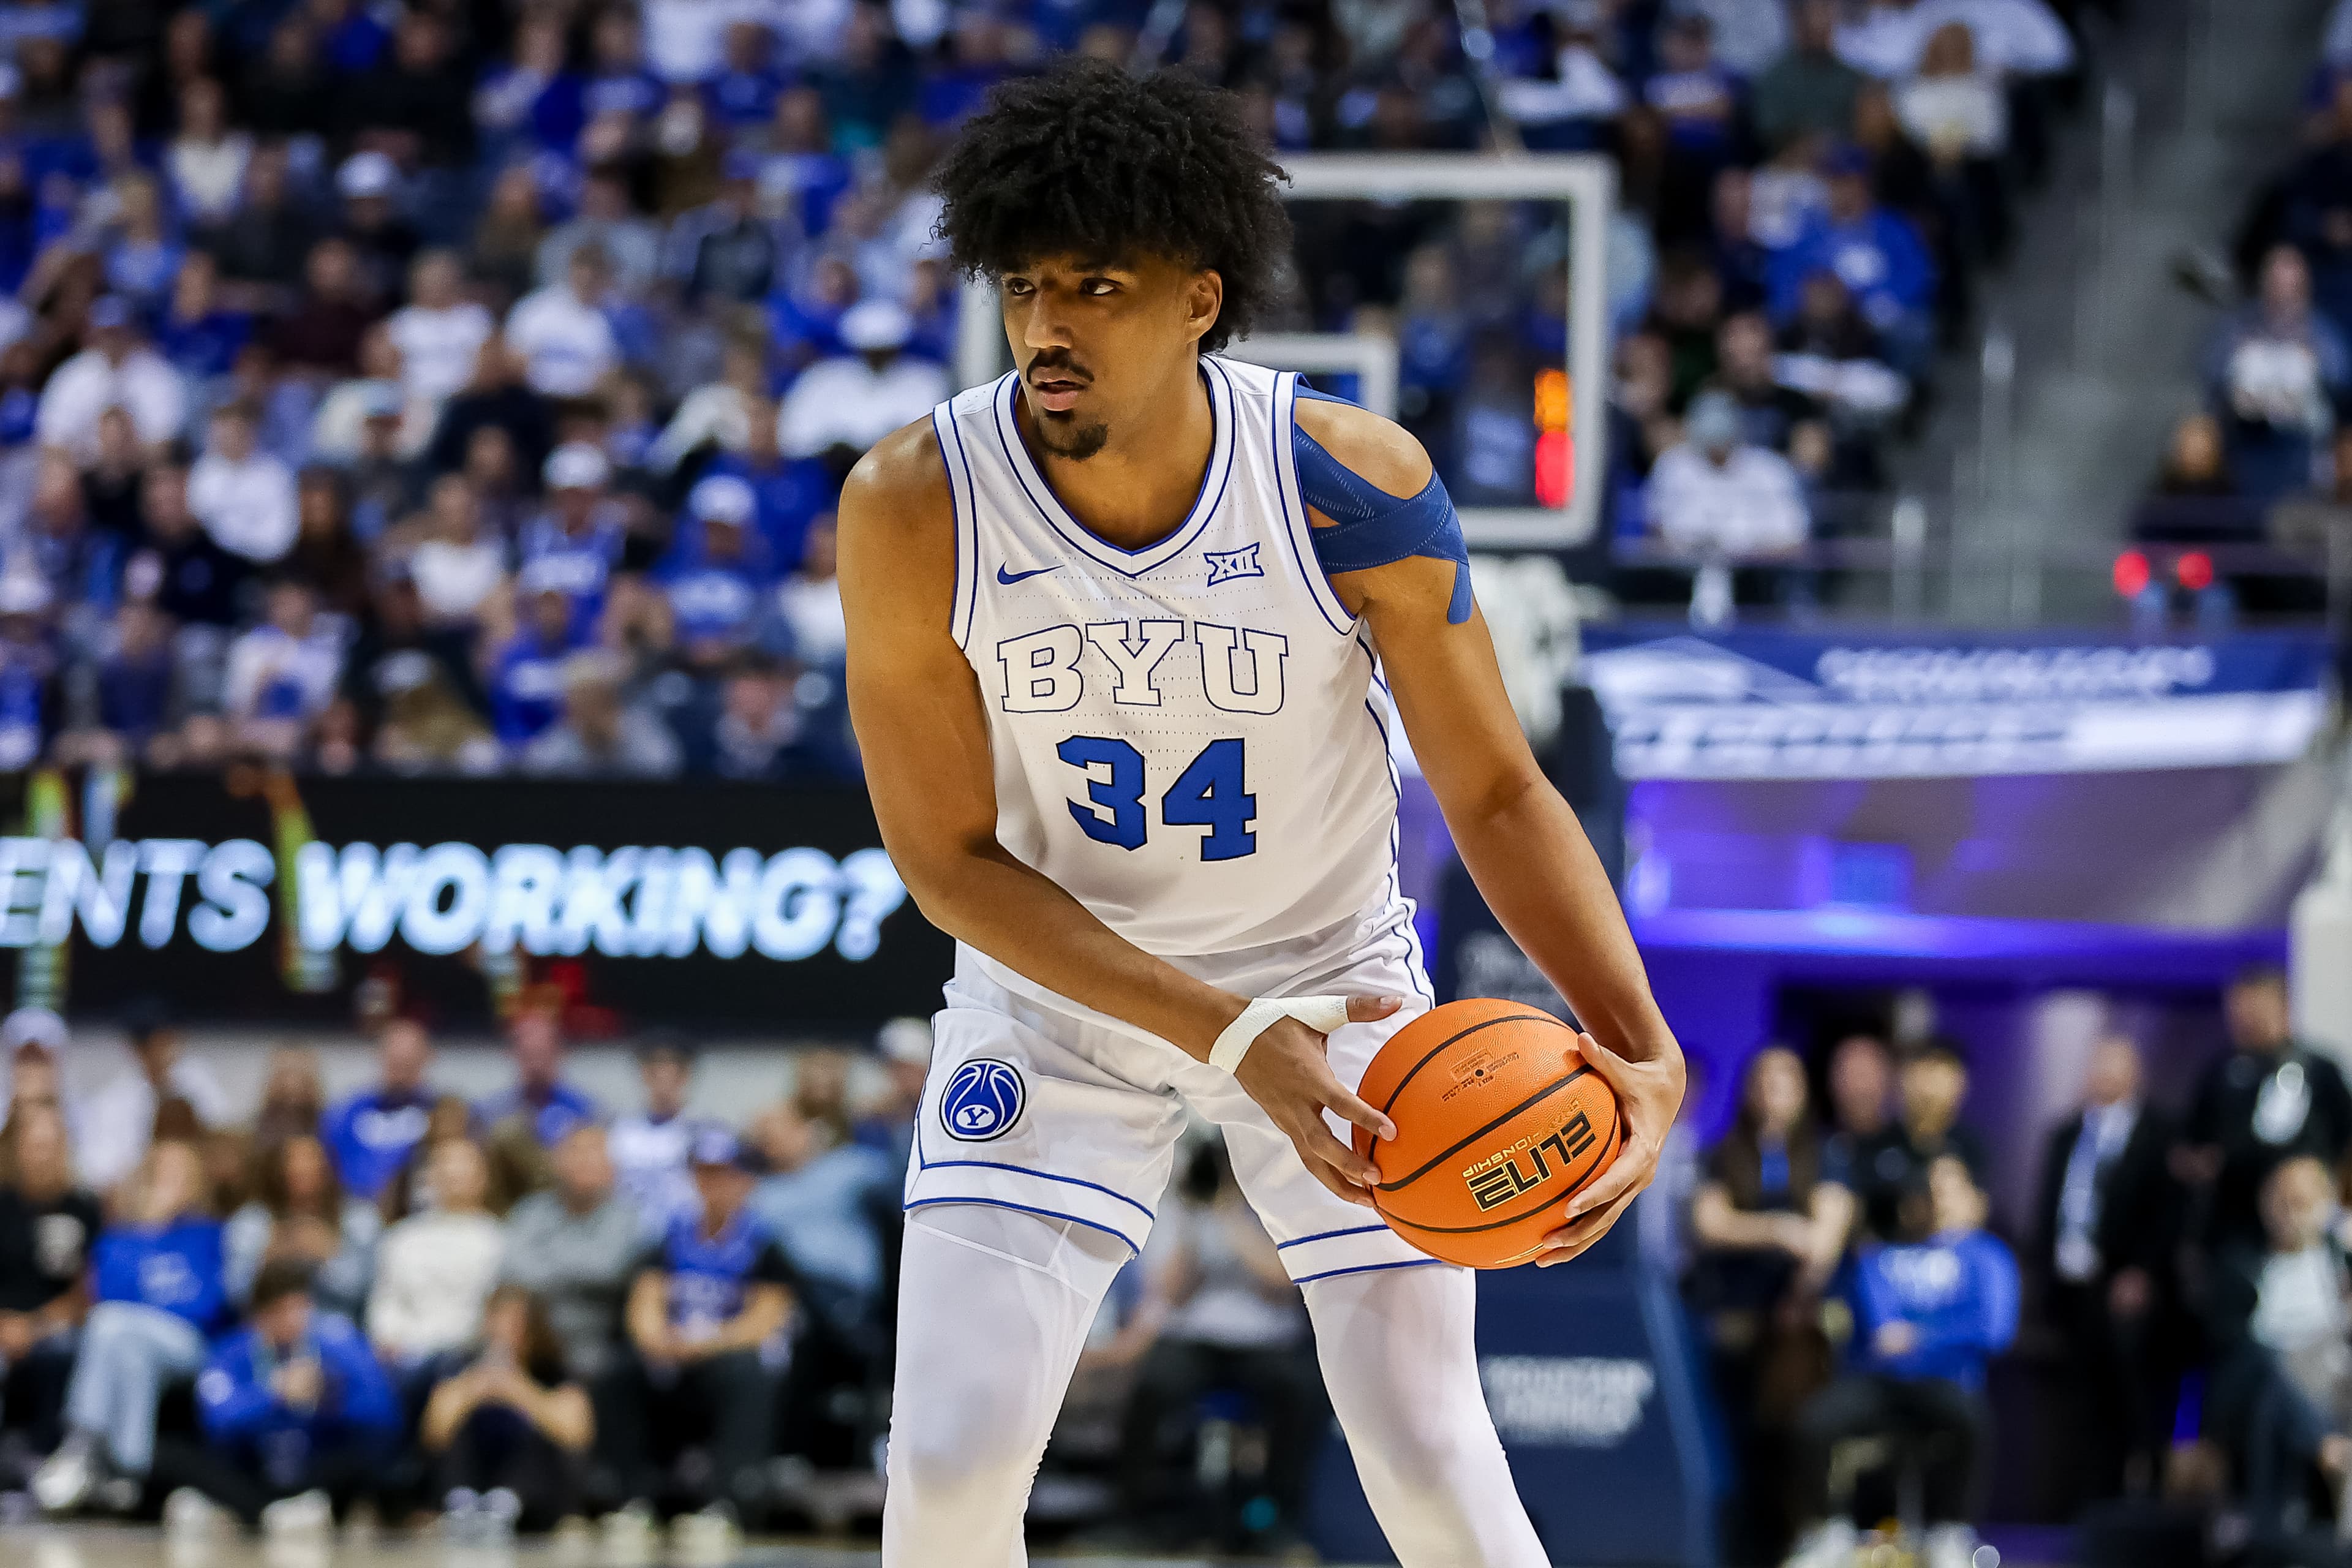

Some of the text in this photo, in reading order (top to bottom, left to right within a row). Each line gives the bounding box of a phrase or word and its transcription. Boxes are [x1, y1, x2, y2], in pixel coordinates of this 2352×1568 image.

[997, 619, 1289, 715] BYU
[1055, 735, 1257, 862] 34
[295, 840, 908, 962] WORKING?
[963, 1107, 989, 1126] Y
[1466, 1109, 1597, 1213] ELITE
